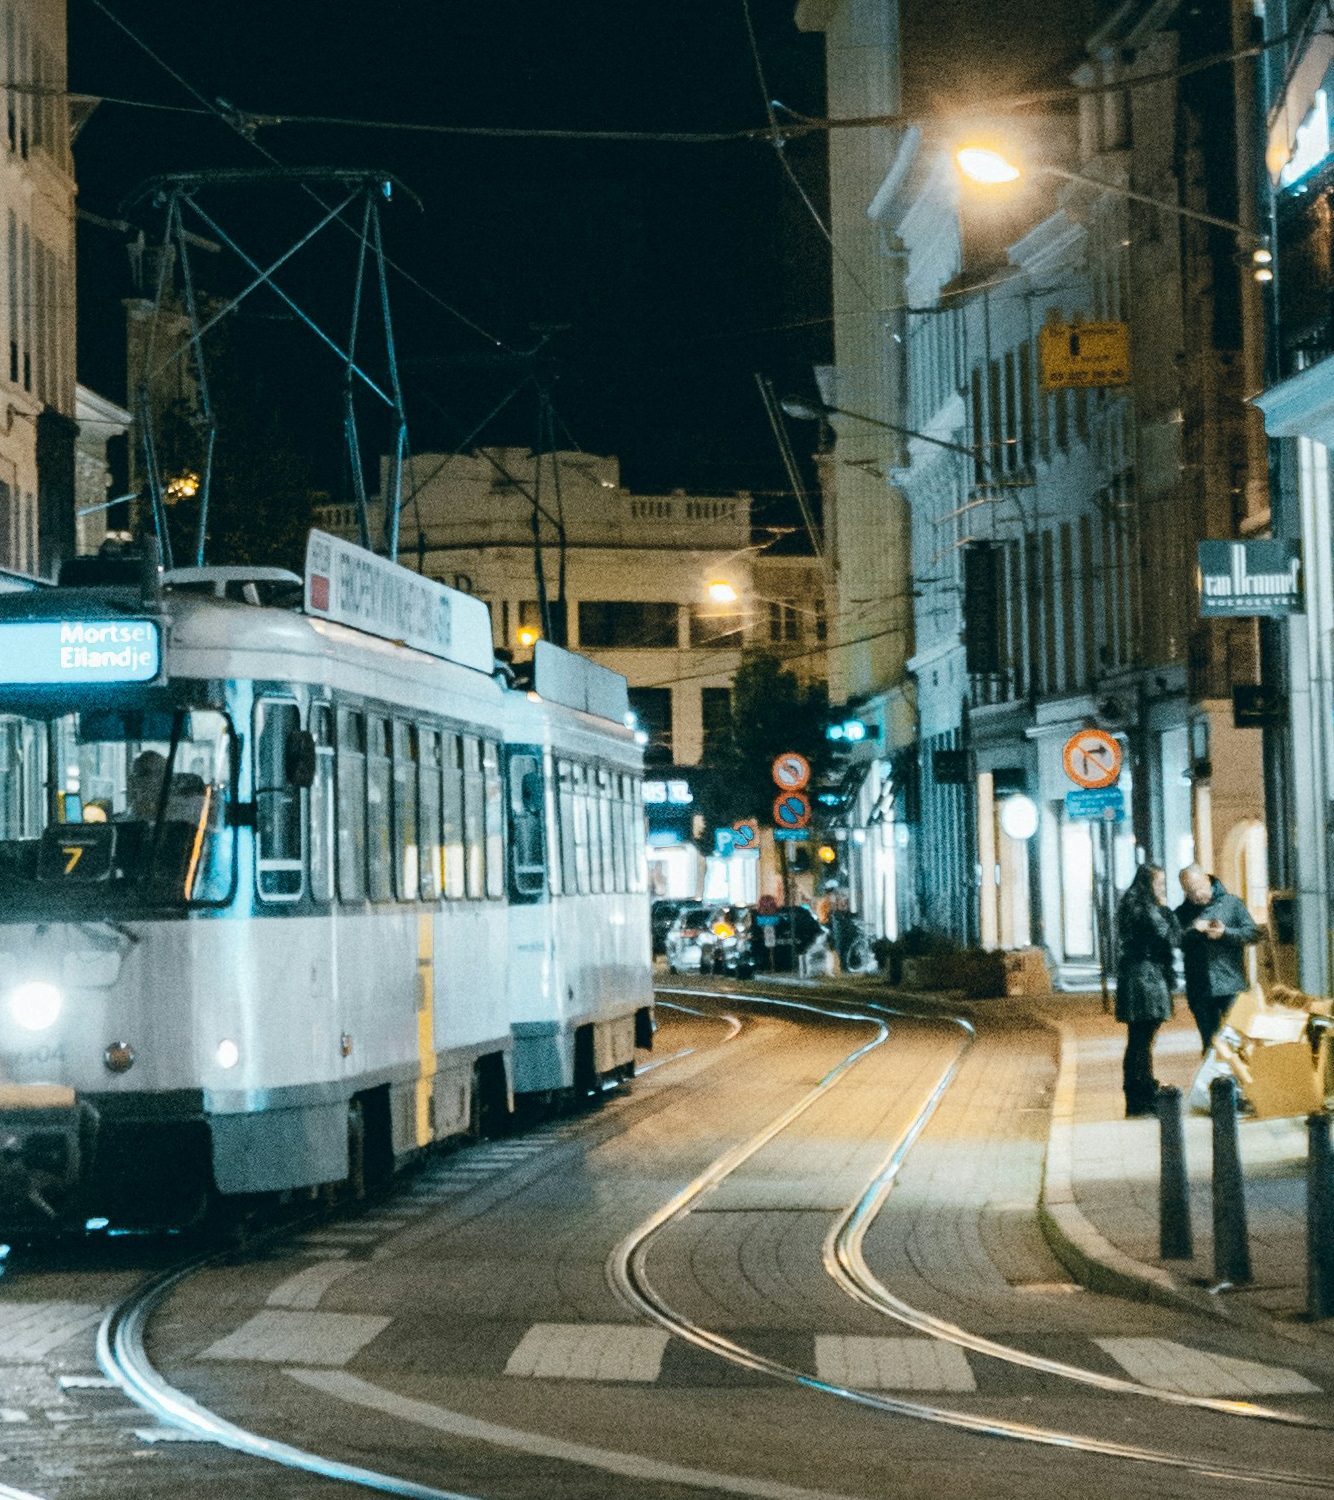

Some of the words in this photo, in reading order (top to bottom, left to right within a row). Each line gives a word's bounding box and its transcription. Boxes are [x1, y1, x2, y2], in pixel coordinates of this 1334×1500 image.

[60, 622, 152, 644] Mortsel
[60, 646, 152, 672] Eilandje
[62, 847, 83, 875] 7
